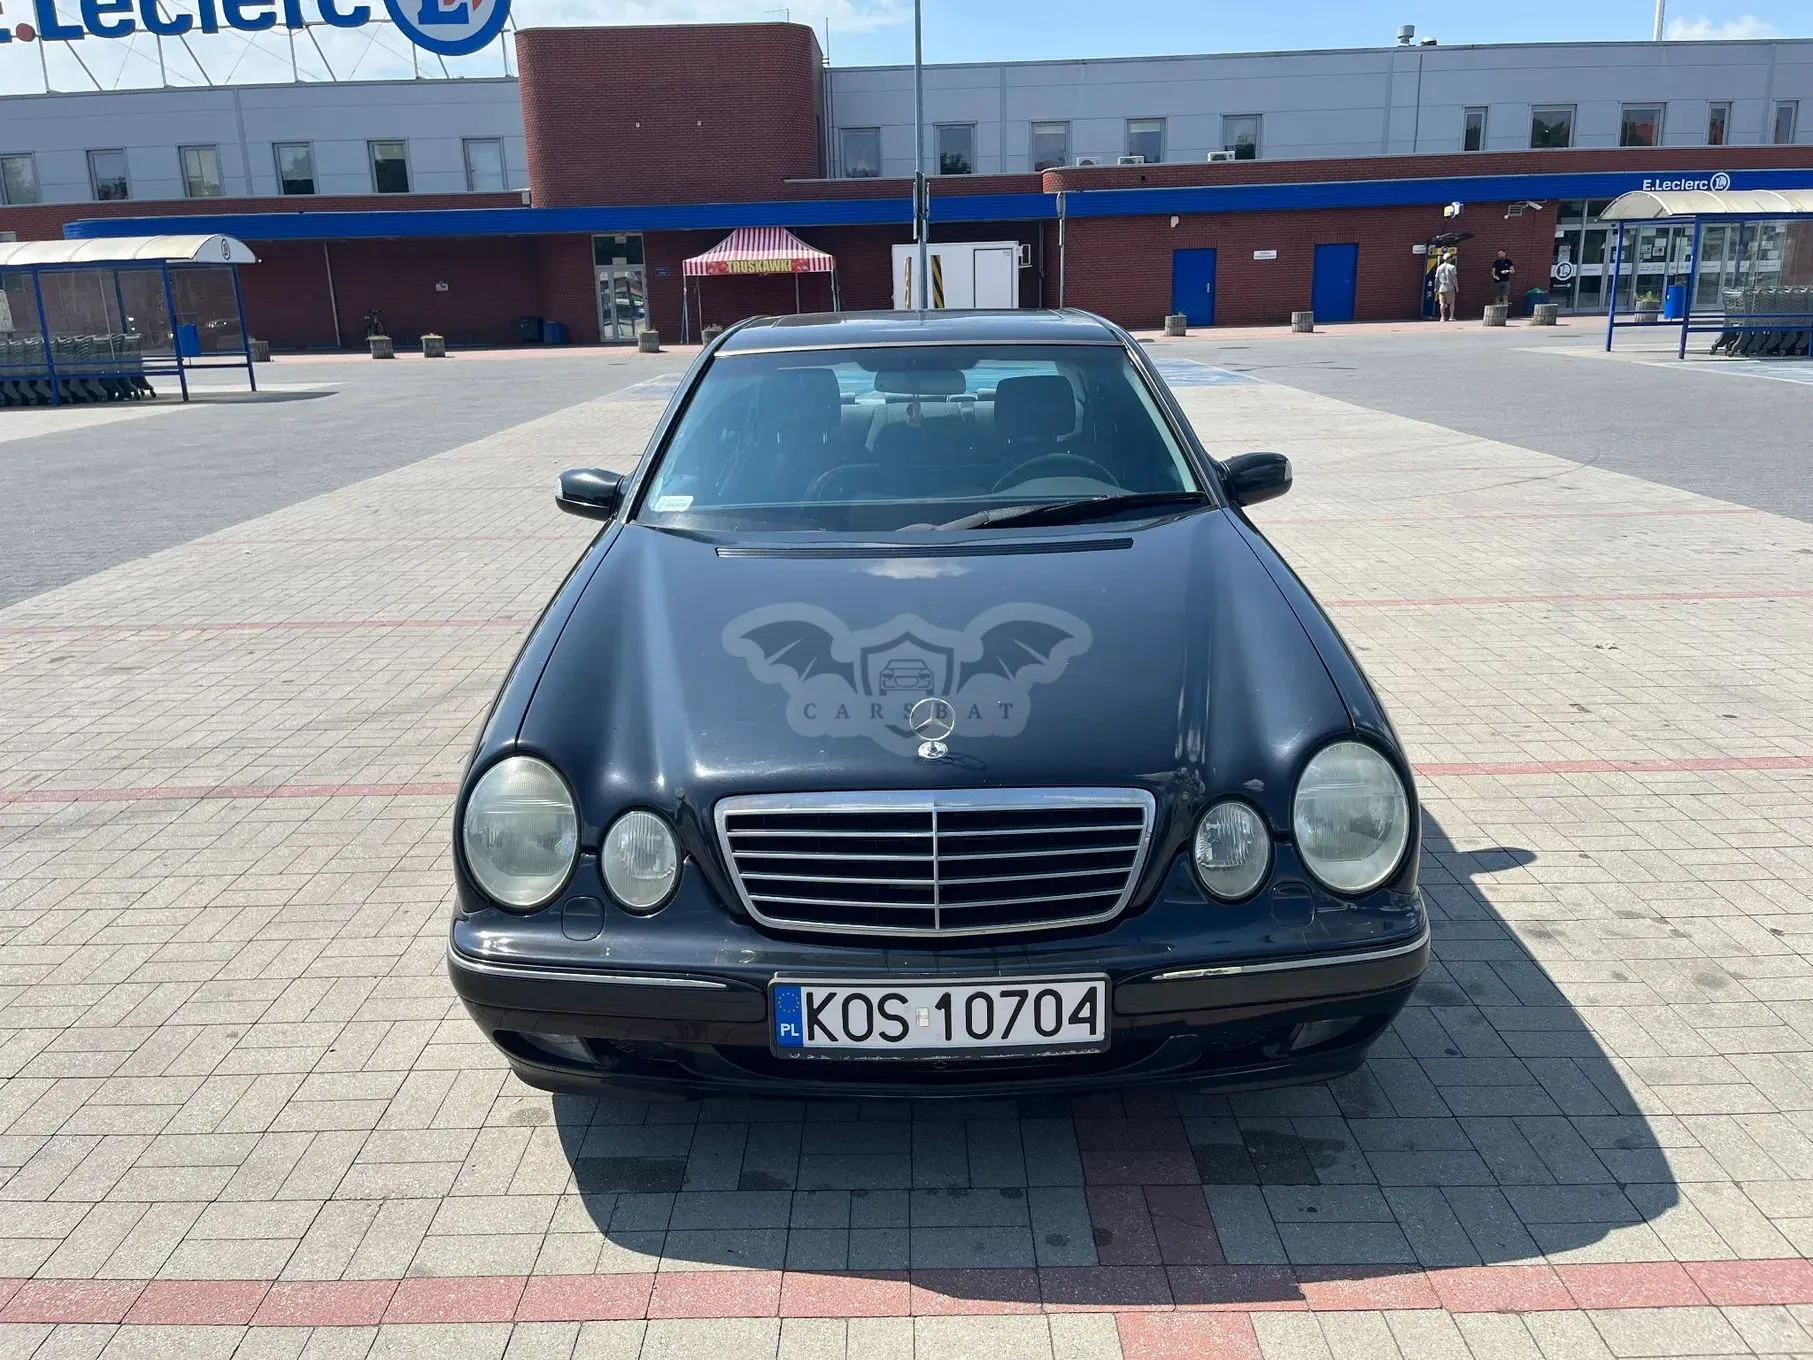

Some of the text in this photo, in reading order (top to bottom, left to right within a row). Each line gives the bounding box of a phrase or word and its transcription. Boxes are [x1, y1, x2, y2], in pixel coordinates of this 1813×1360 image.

[0, 0, 371, 43] .Leclerc
[1642, 179, 1708, 191] E.Leclerc
[726, 259, 792, 273] TRUSKAWKI
[806, 985, 1098, 1042] KOS 10704
[780, 1023, 799, 1037] PL
